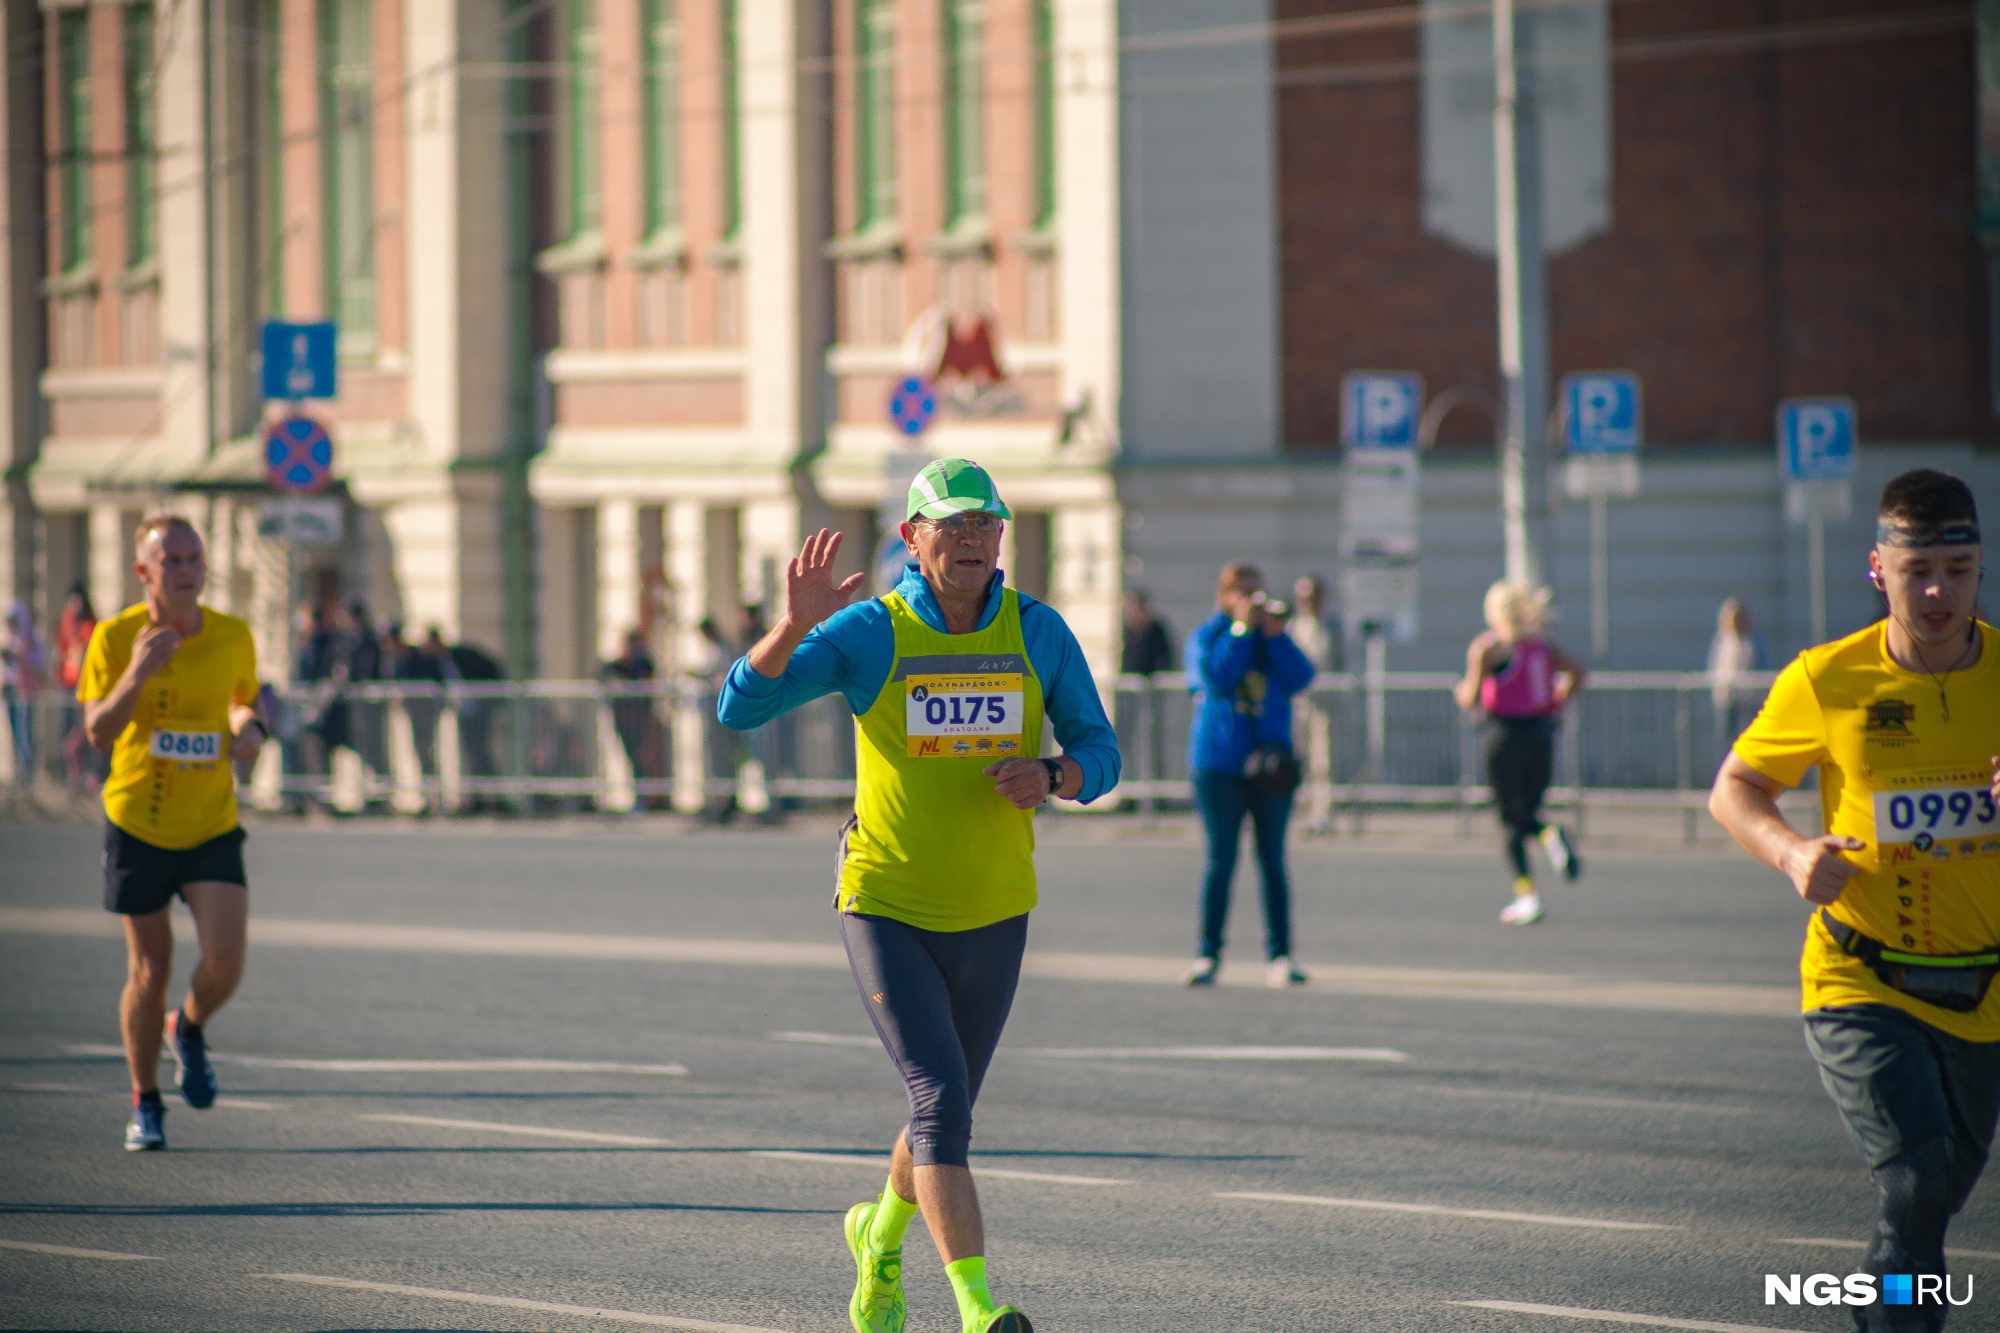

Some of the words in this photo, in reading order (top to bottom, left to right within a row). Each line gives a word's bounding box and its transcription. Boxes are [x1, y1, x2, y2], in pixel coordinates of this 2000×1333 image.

[925, 696, 1006, 725] 0175
[943, 725, 991, 733] АНАТОЛИЙ
[159, 732, 215, 755] 0801
[918, 735, 941, 757] NL
[1889, 790, 1997, 830] 0993
